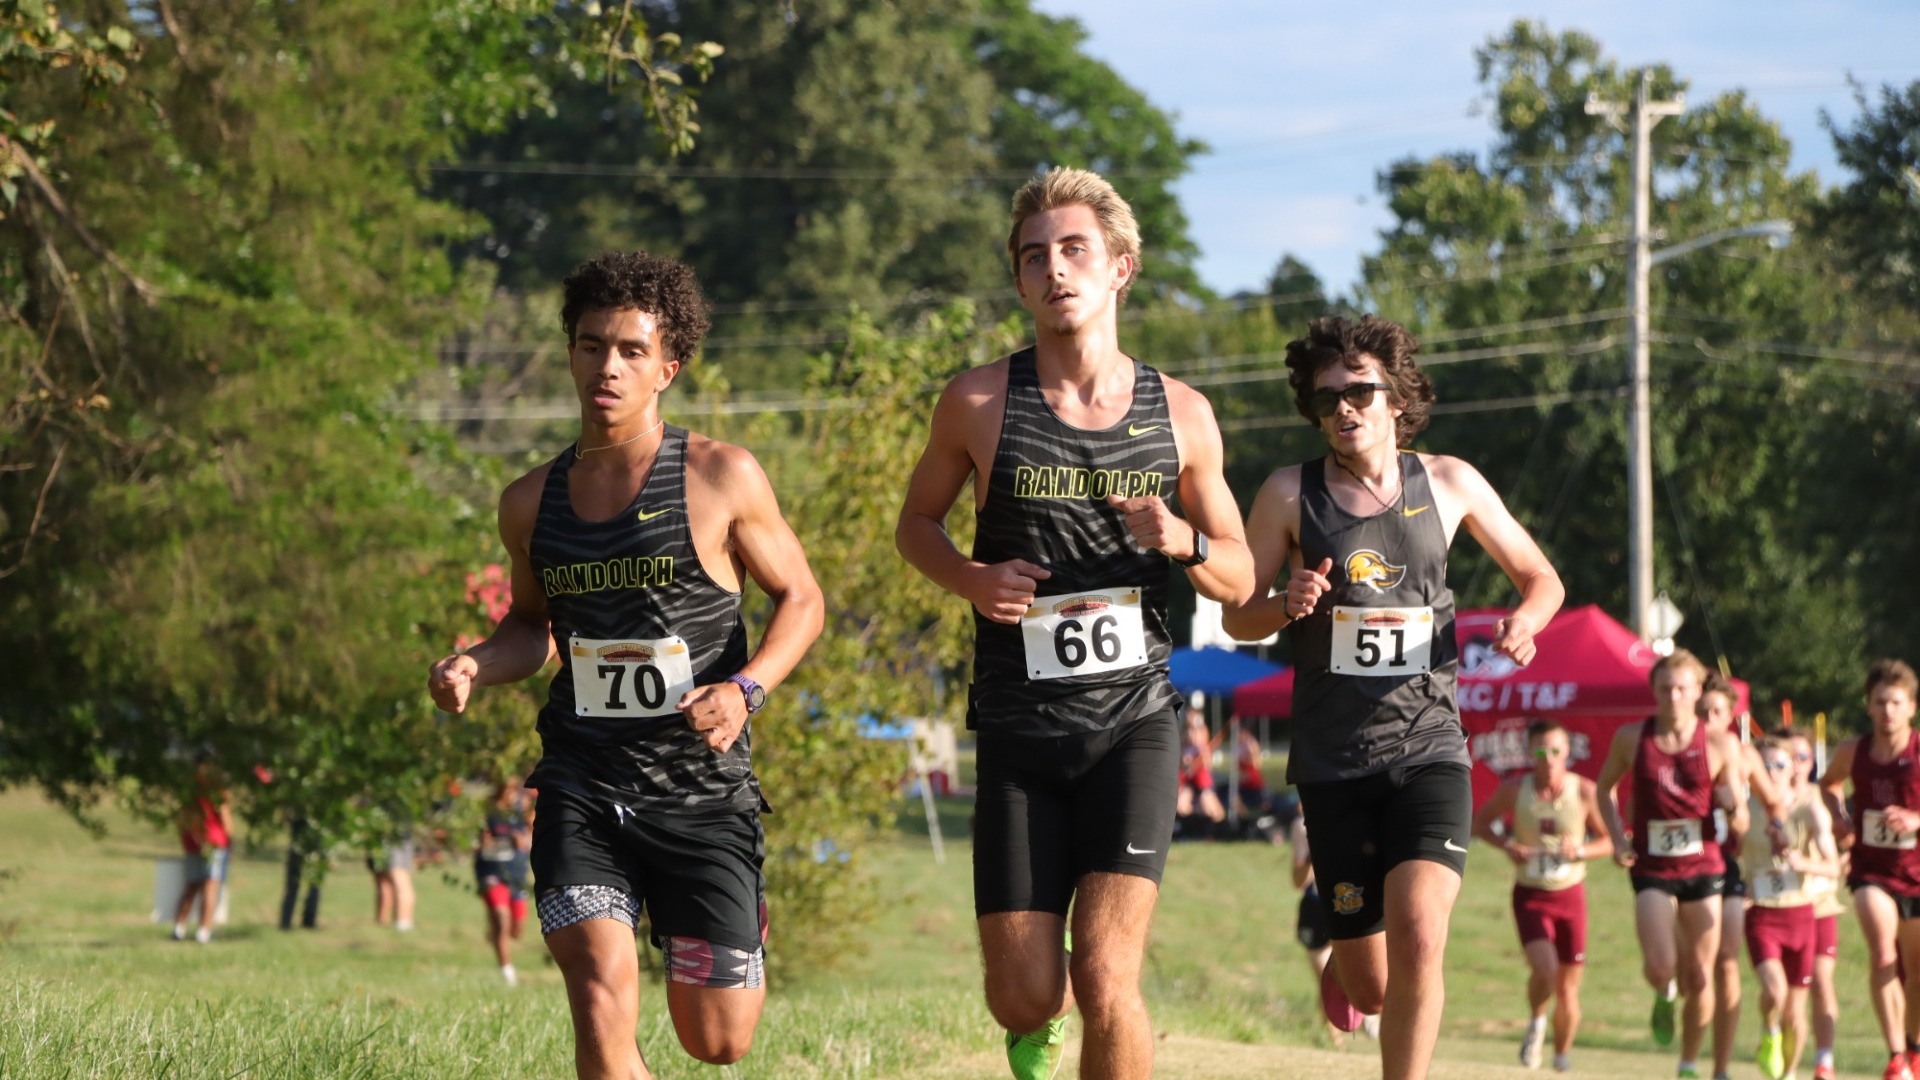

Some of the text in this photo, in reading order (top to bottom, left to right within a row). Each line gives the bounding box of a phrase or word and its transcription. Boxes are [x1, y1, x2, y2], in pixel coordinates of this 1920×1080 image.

[1014, 466, 1162, 500] RANDOLPH
[544, 556, 674, 598] RANDOLPH
[1053, 614, 1123, 669] 66
[1354, 628, 1407, 668] 51
[597, 664, 667, 710] 70
[1515, 682, 1578, 711] T&F
[1660, 829, 1690, 852] 33
